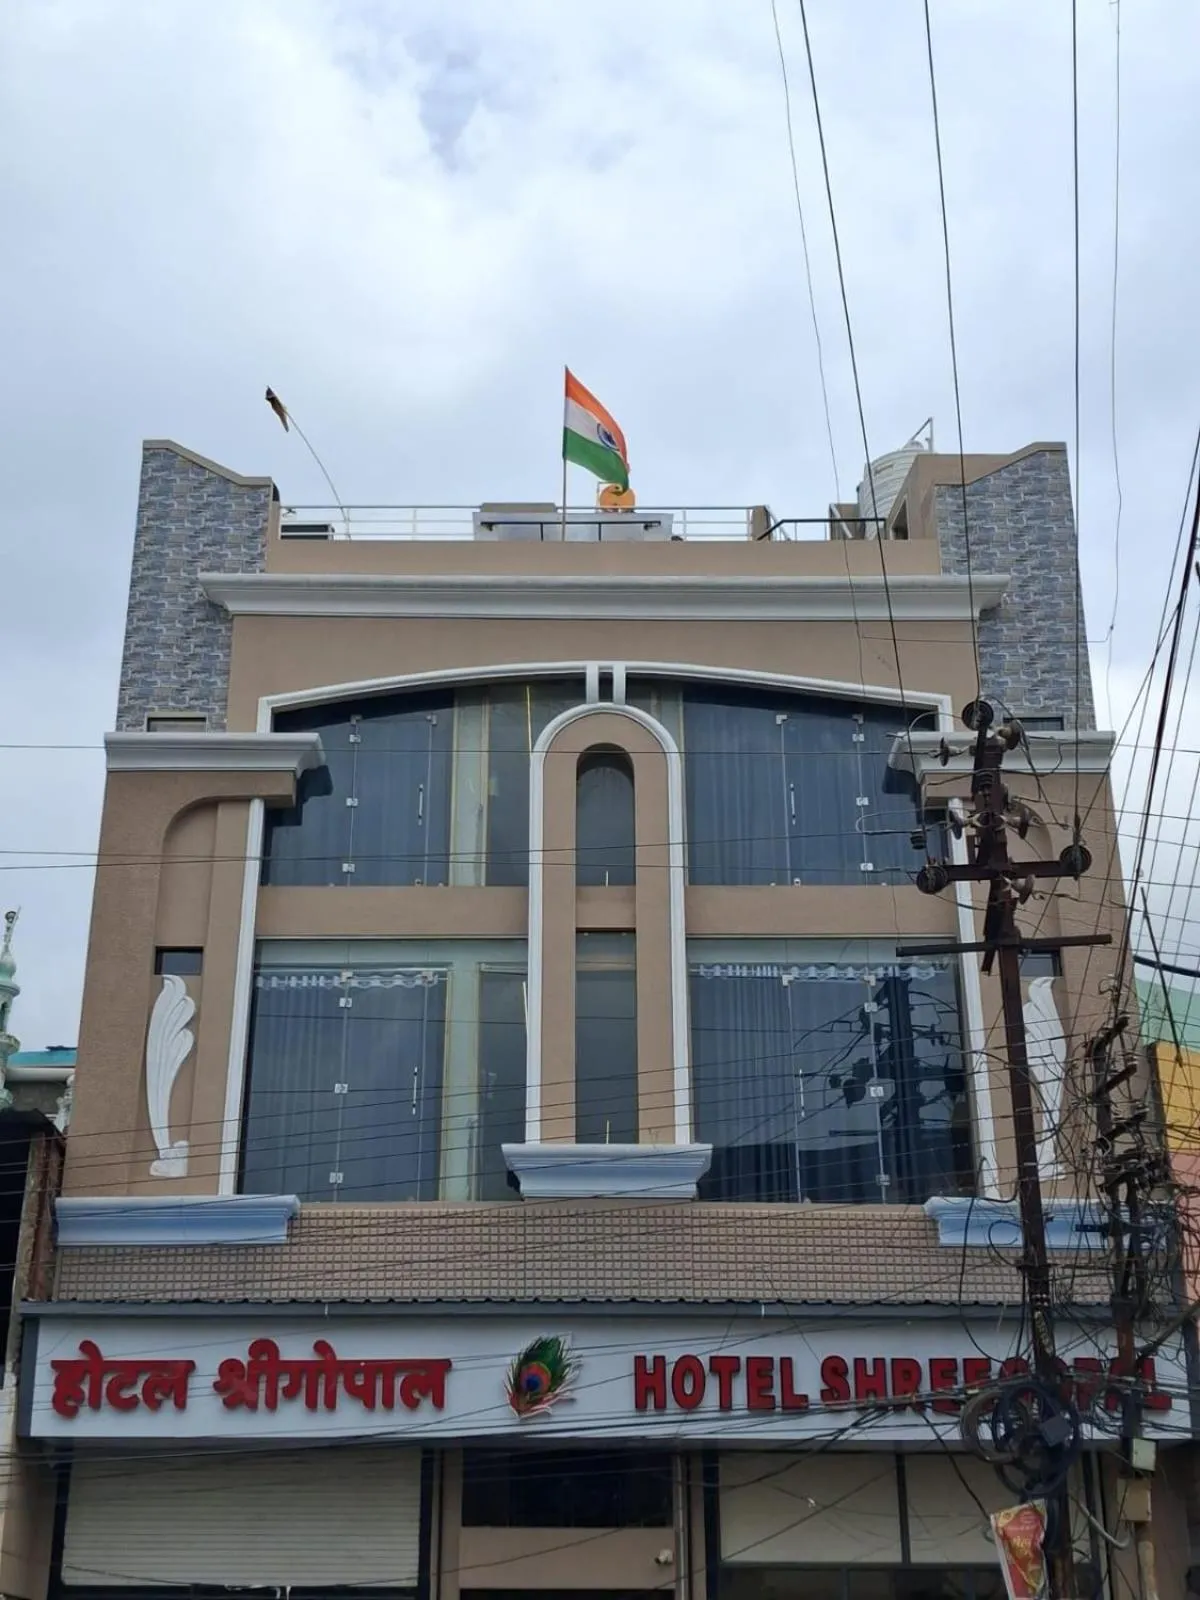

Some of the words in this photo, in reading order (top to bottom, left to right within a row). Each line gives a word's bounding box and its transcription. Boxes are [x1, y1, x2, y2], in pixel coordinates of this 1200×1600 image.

[51, 1340, 195, 1416] होटल
[214, 1339, 452, 1411] श्रीगोपाल
[634, 1354, 808, 1410] HOTEL
